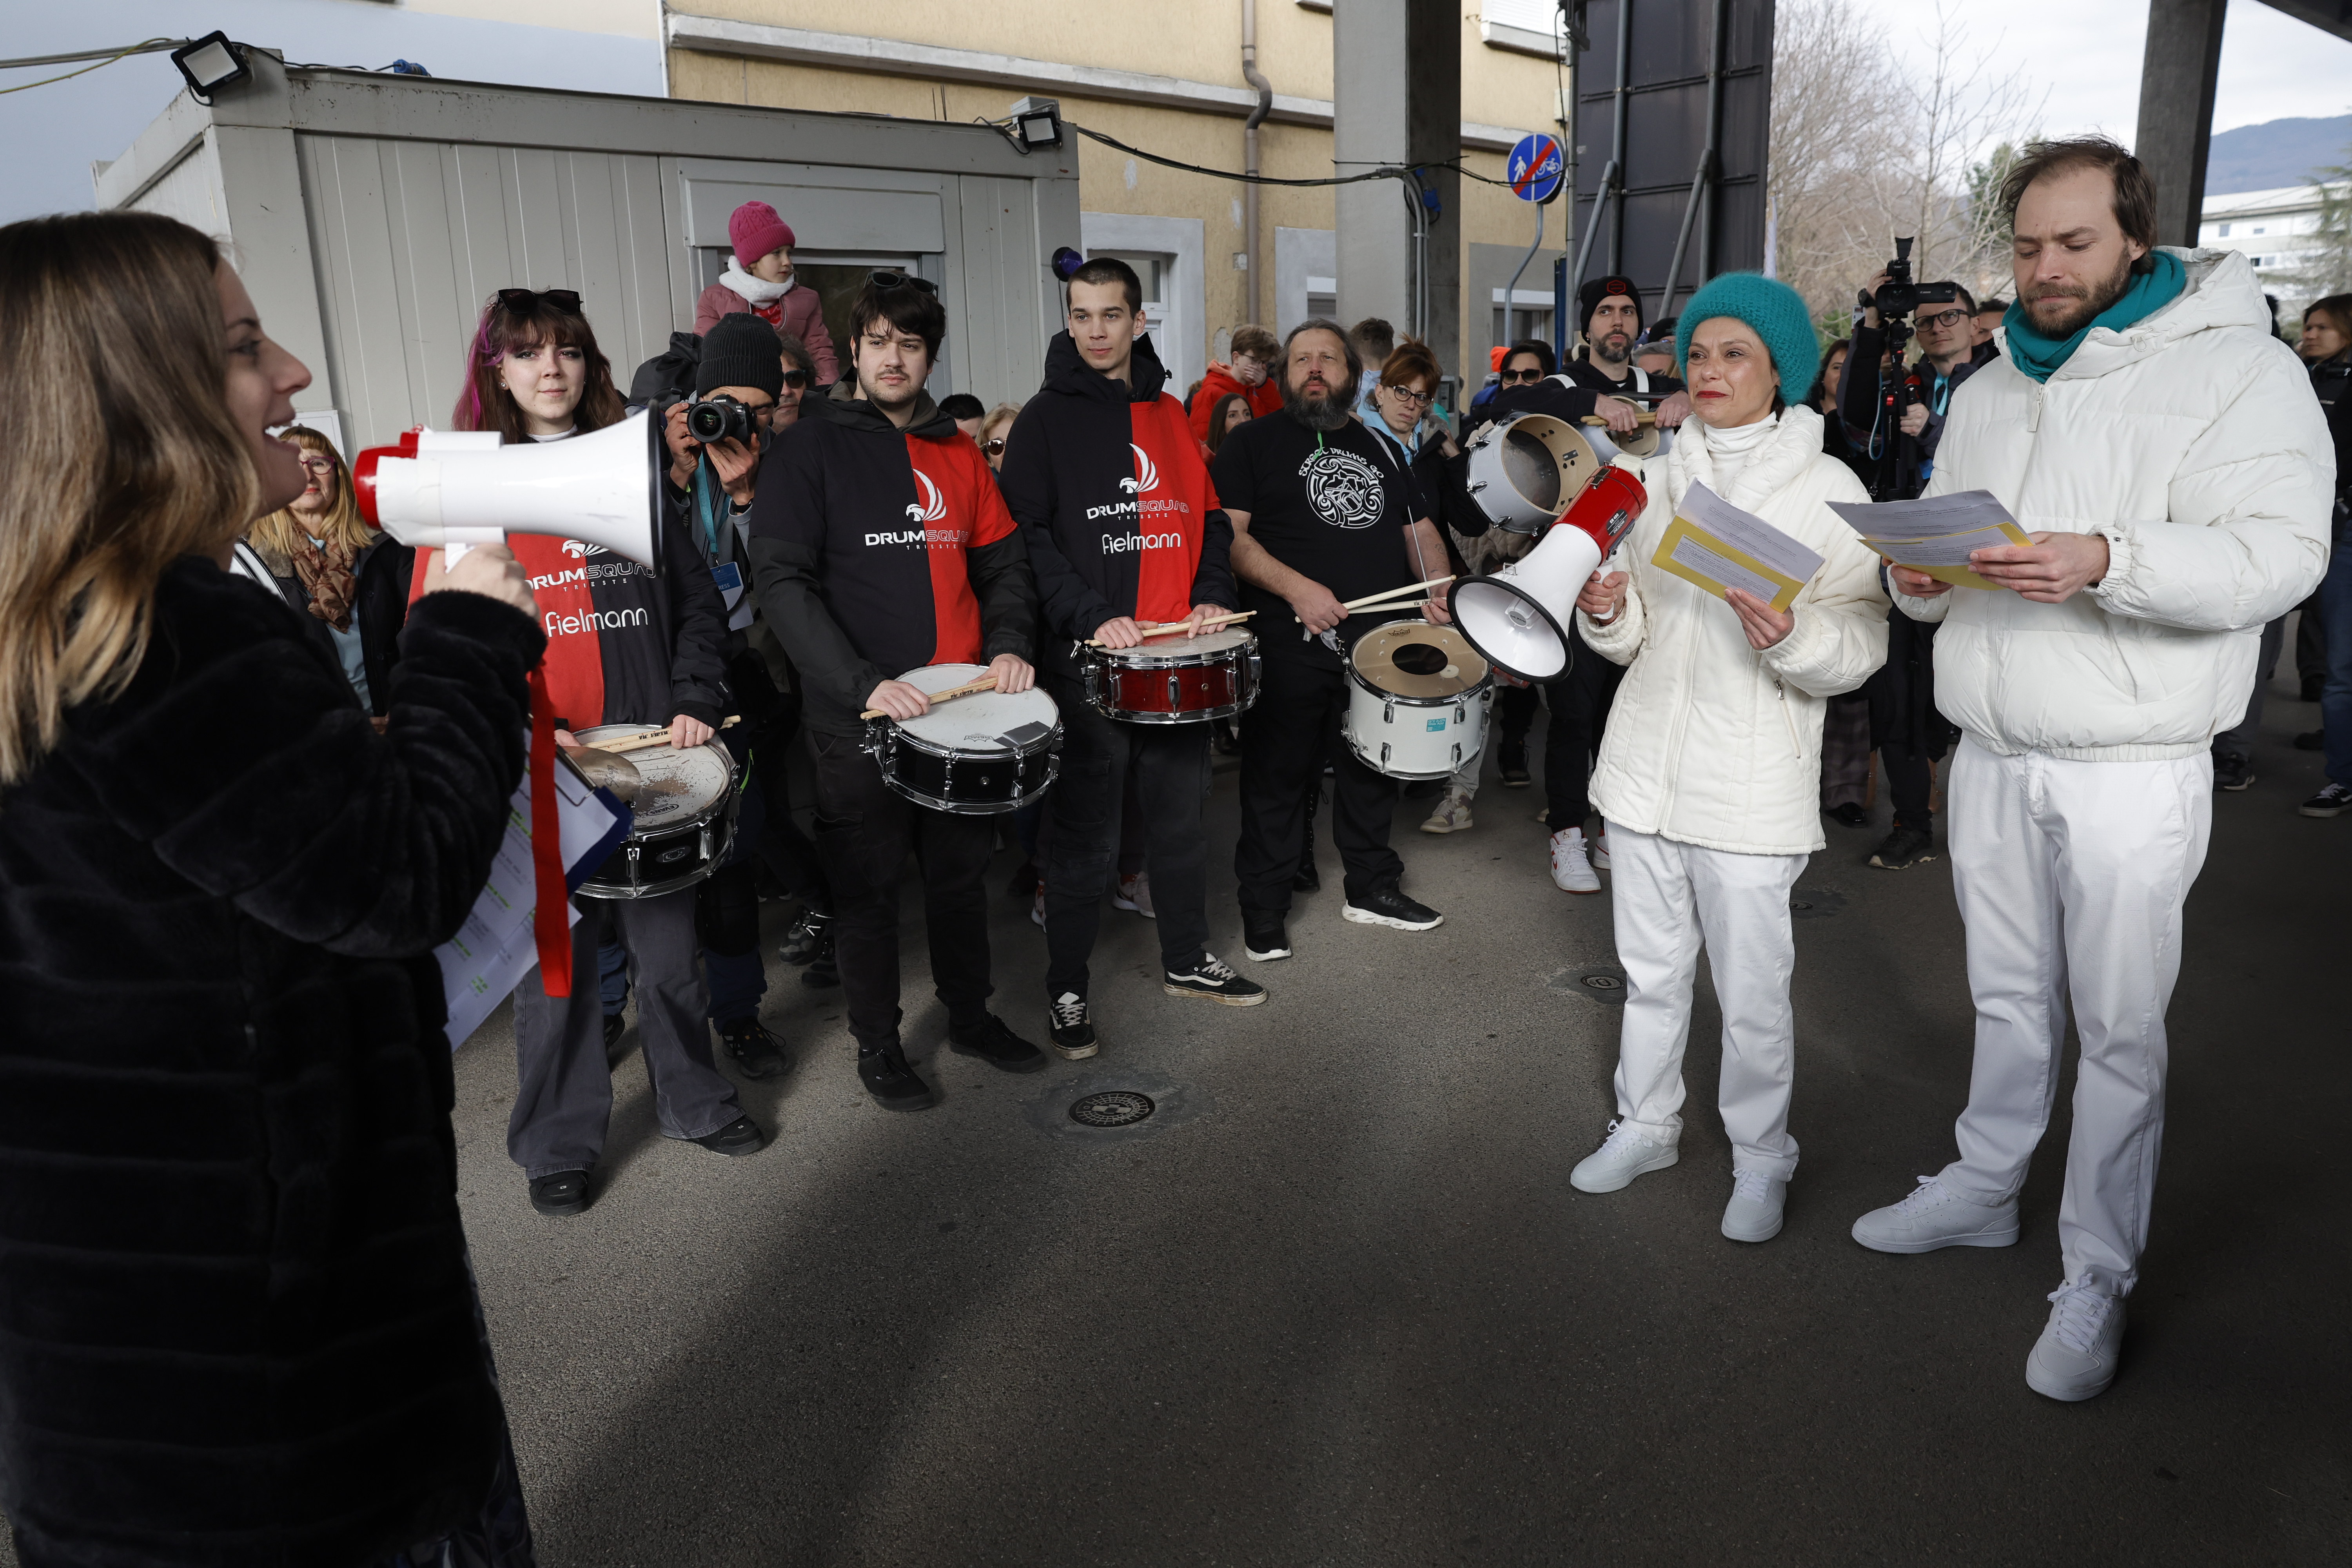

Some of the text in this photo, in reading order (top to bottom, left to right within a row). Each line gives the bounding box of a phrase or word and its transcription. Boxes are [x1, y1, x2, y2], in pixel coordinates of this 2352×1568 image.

[1329, 447, 1368, 465] DRUMS
[1370, 465, 1385, 479] GO
[1086, 499, 1189, 520] DRUMSQUAD
[1613, 520, 1625, 534] DEXON
[865, 530, 969, 546] DRUMSQUAD
[1102, 531, 1181, 555] fielmann
[563, 578, 627, 592] TRIESTE
[545, 608, 648, 637] fielmann
[1510, 615, 1526, 623] DEXON
[650, 805, 675, 815] EVANS
